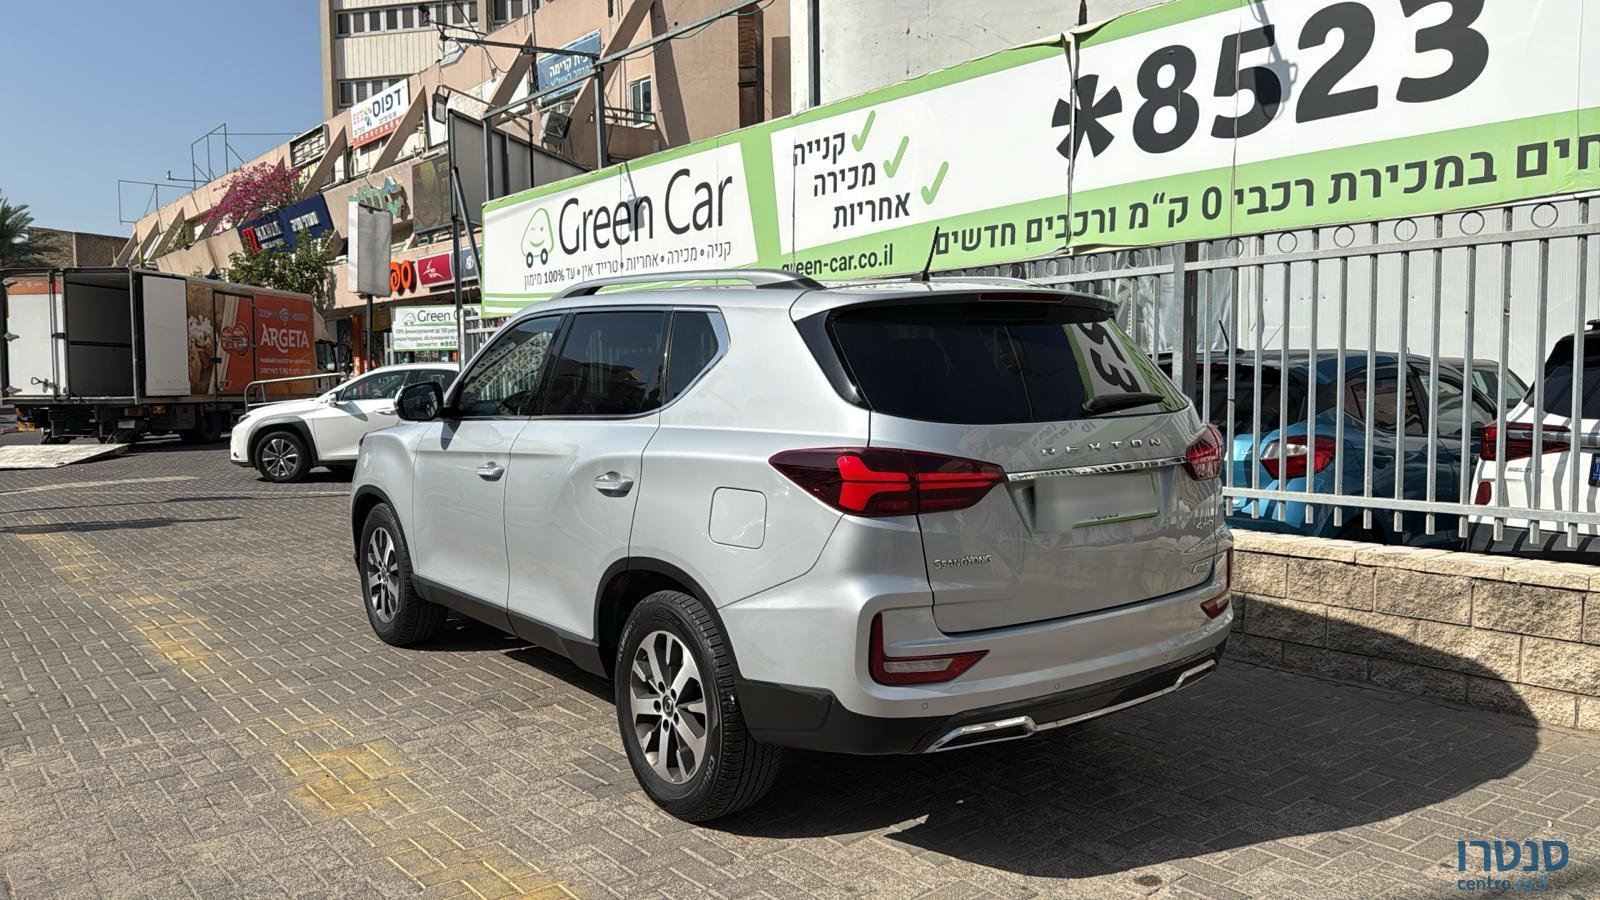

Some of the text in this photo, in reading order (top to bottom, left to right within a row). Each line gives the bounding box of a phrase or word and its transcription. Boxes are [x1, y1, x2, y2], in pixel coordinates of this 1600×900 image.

[372, 88, 402, 118] דפוס
[793, 132, 846, 167] קנייה
[813, 162, 876, 197] מכירה
[1327, 151, 1498, 205] במכירת
[558, 167, 733, 256] Green Car
[832, 192, 911, 230] אחריות
[1201, 186, 1223, 221] 0
[1233, 178, 1315, 216] רכבי
[934, 222, 1017, 256] חדשים
[1026, 206, 1117, 243] ורכבים
[524, 241, 732, 292] קניה מכירה אחריות טרייד אין עד 100% מימון
[417, 309, 451, 323] Green
[260, 323, 310, 354] ARGETA
[1041, 437, 1162, 457] REXTON
[933, 552, 993, 570] SSANGYONG
